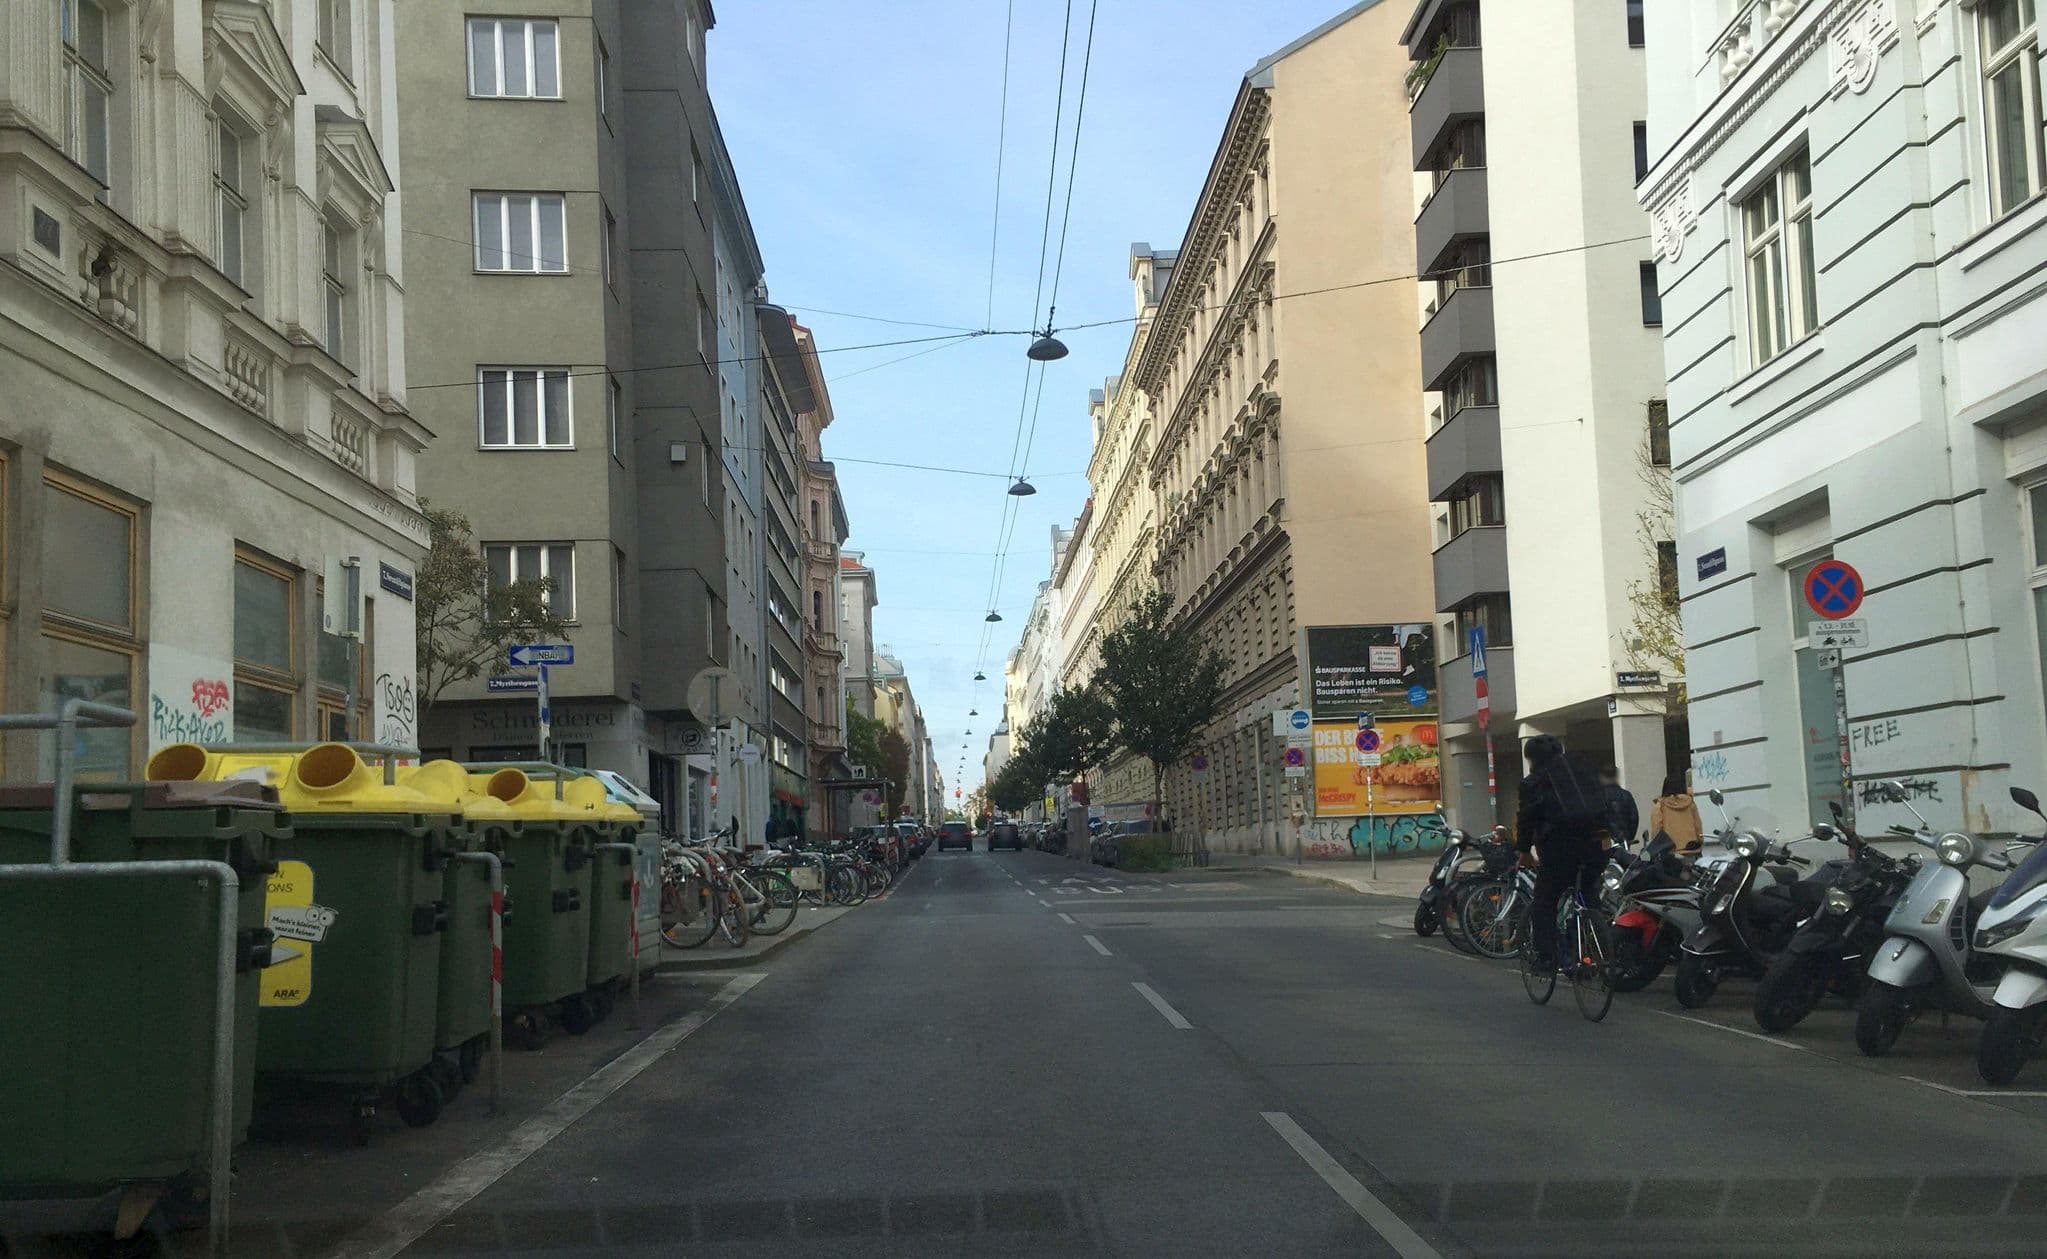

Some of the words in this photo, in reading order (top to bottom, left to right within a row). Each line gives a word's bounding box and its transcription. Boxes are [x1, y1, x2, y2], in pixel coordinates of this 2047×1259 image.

[1331, 679, 1355, 687] Leben
[1316, 688, 1357, 696] Bausparen
[472, 706, 616, 729] Schniderei
[1314, 729, 1342, 746] DER
[1851, 720, 1901, 752] FREE
